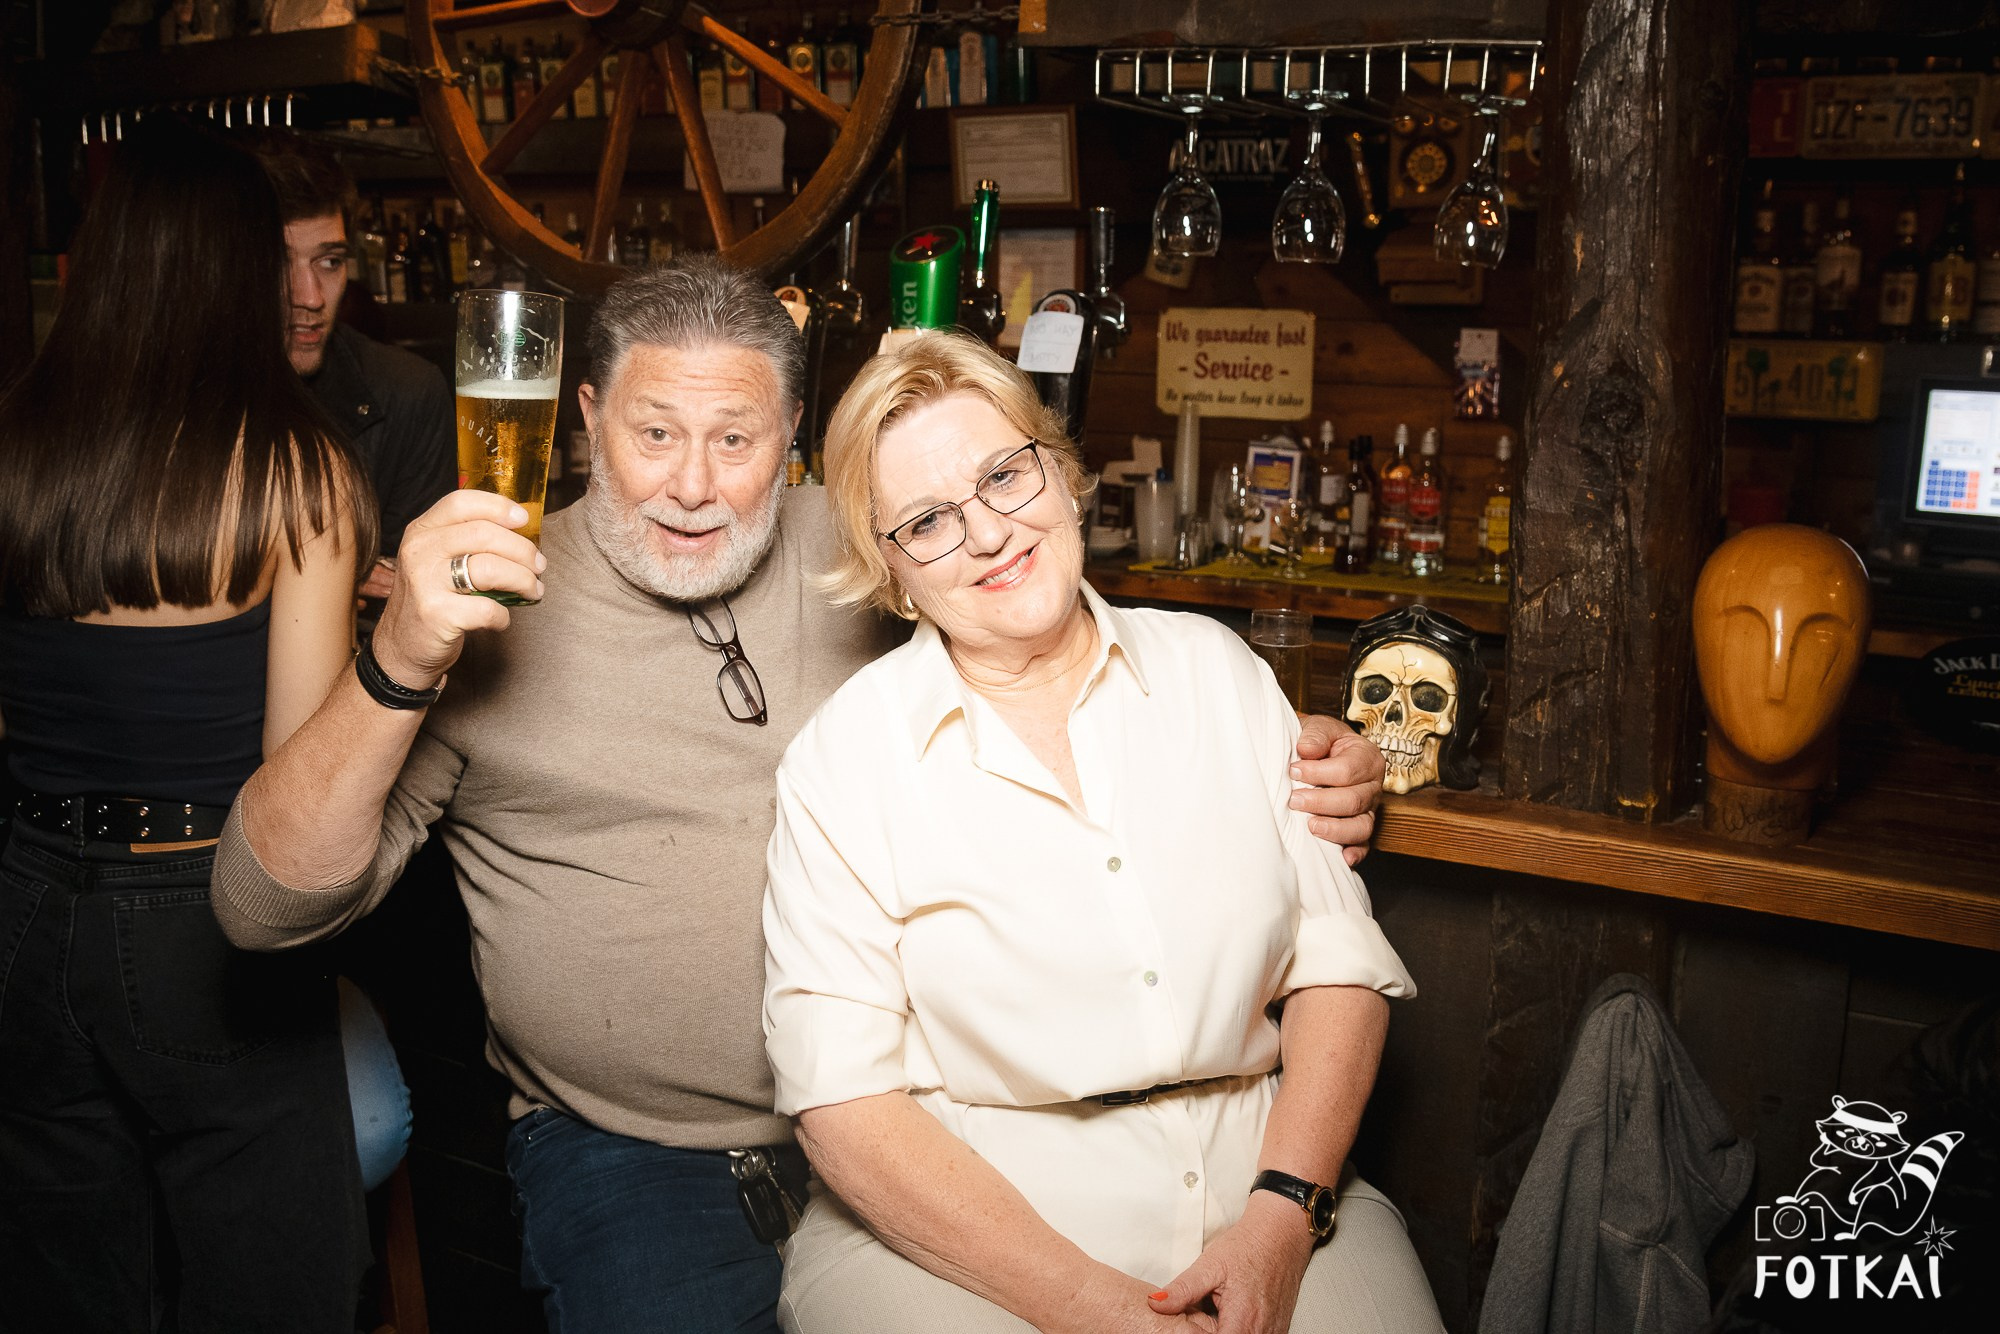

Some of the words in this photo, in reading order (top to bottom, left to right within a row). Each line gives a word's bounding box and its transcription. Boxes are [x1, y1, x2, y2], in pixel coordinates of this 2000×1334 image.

[1168, 138, 1289, 173] ACATRAZ
[1165, 320, 1188, 343] We
[1196, 324, 1270, 348] guarantee
[1276, 322, 1306, 350] fast
[1194, 352, 1273, 382] Service
[460, 415, 504, 476] QUALITY
[1933, 655, 1987, 675] JACK
